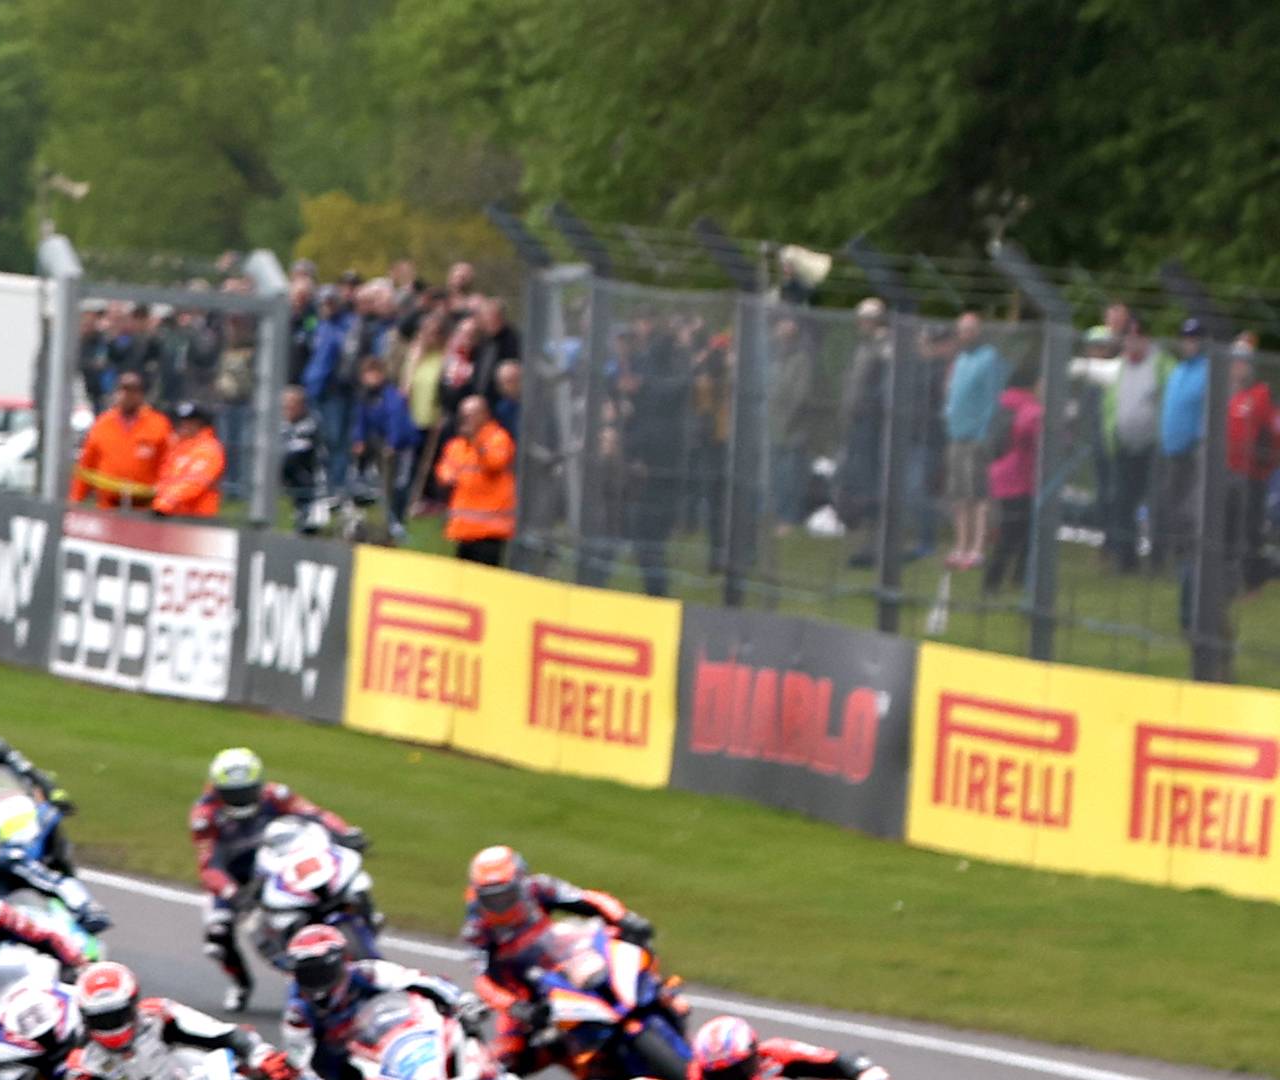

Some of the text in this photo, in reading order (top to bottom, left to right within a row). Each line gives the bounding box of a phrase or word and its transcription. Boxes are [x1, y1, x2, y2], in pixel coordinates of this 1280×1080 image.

[361, 587, 484, 712] PIRELLI
[528, 619, 653, 748] PIRELLI
[690, 652, 880, 781] DIABLO
[931, 691, 1079, 830] PIRELLI
[1128, 722, 1280, 859] PIRELLI
